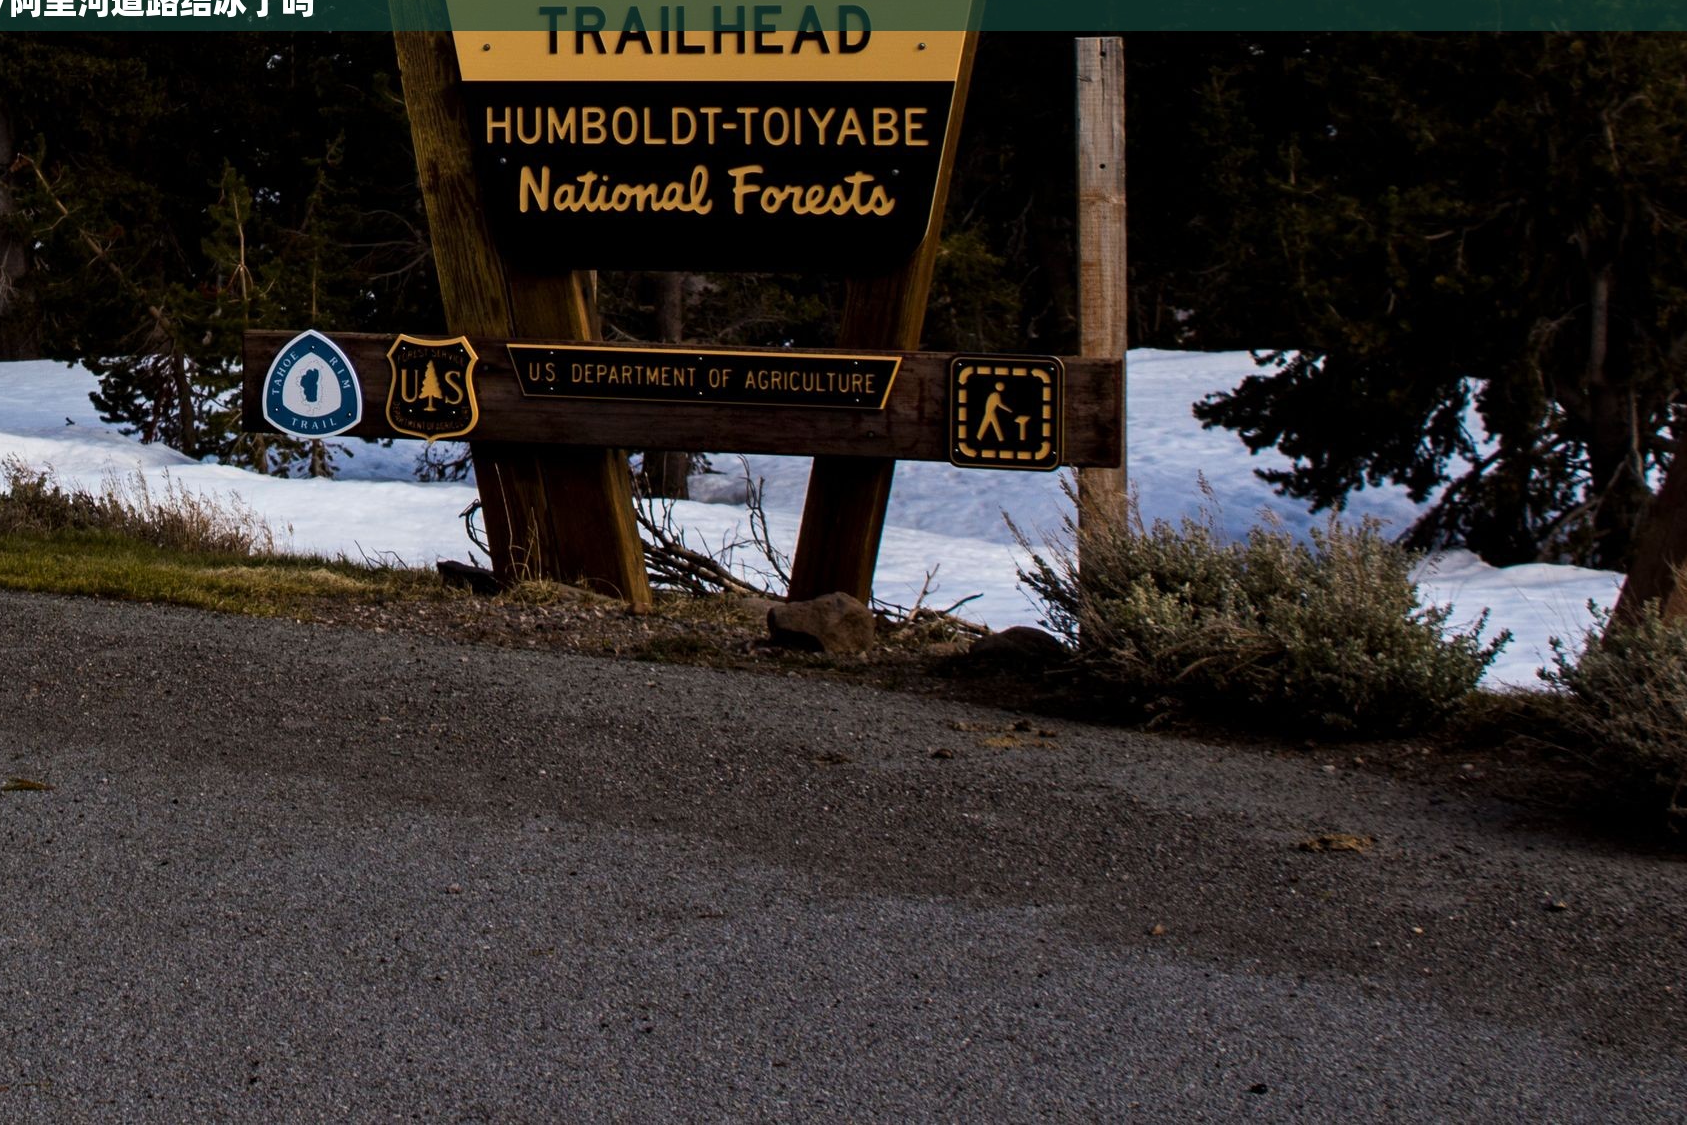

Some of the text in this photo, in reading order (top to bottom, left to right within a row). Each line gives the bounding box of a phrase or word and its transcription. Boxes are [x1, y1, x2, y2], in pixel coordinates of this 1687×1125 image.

[539, 5, 872, 55] TRAILHEAD
[486, 106, 929, 147] HUMBOLDT-TOIYABE
[519, 164, 896, 217] National Forests
[272, 351, 352, 395] TAHOE RIM
[571, 363, 696, 388] DEPARTMENT
[708, 368, 730, 389] OF
[744, 369, 877, 395] AGRICULTURE
[291, 417, 338, 430] TRAIL
